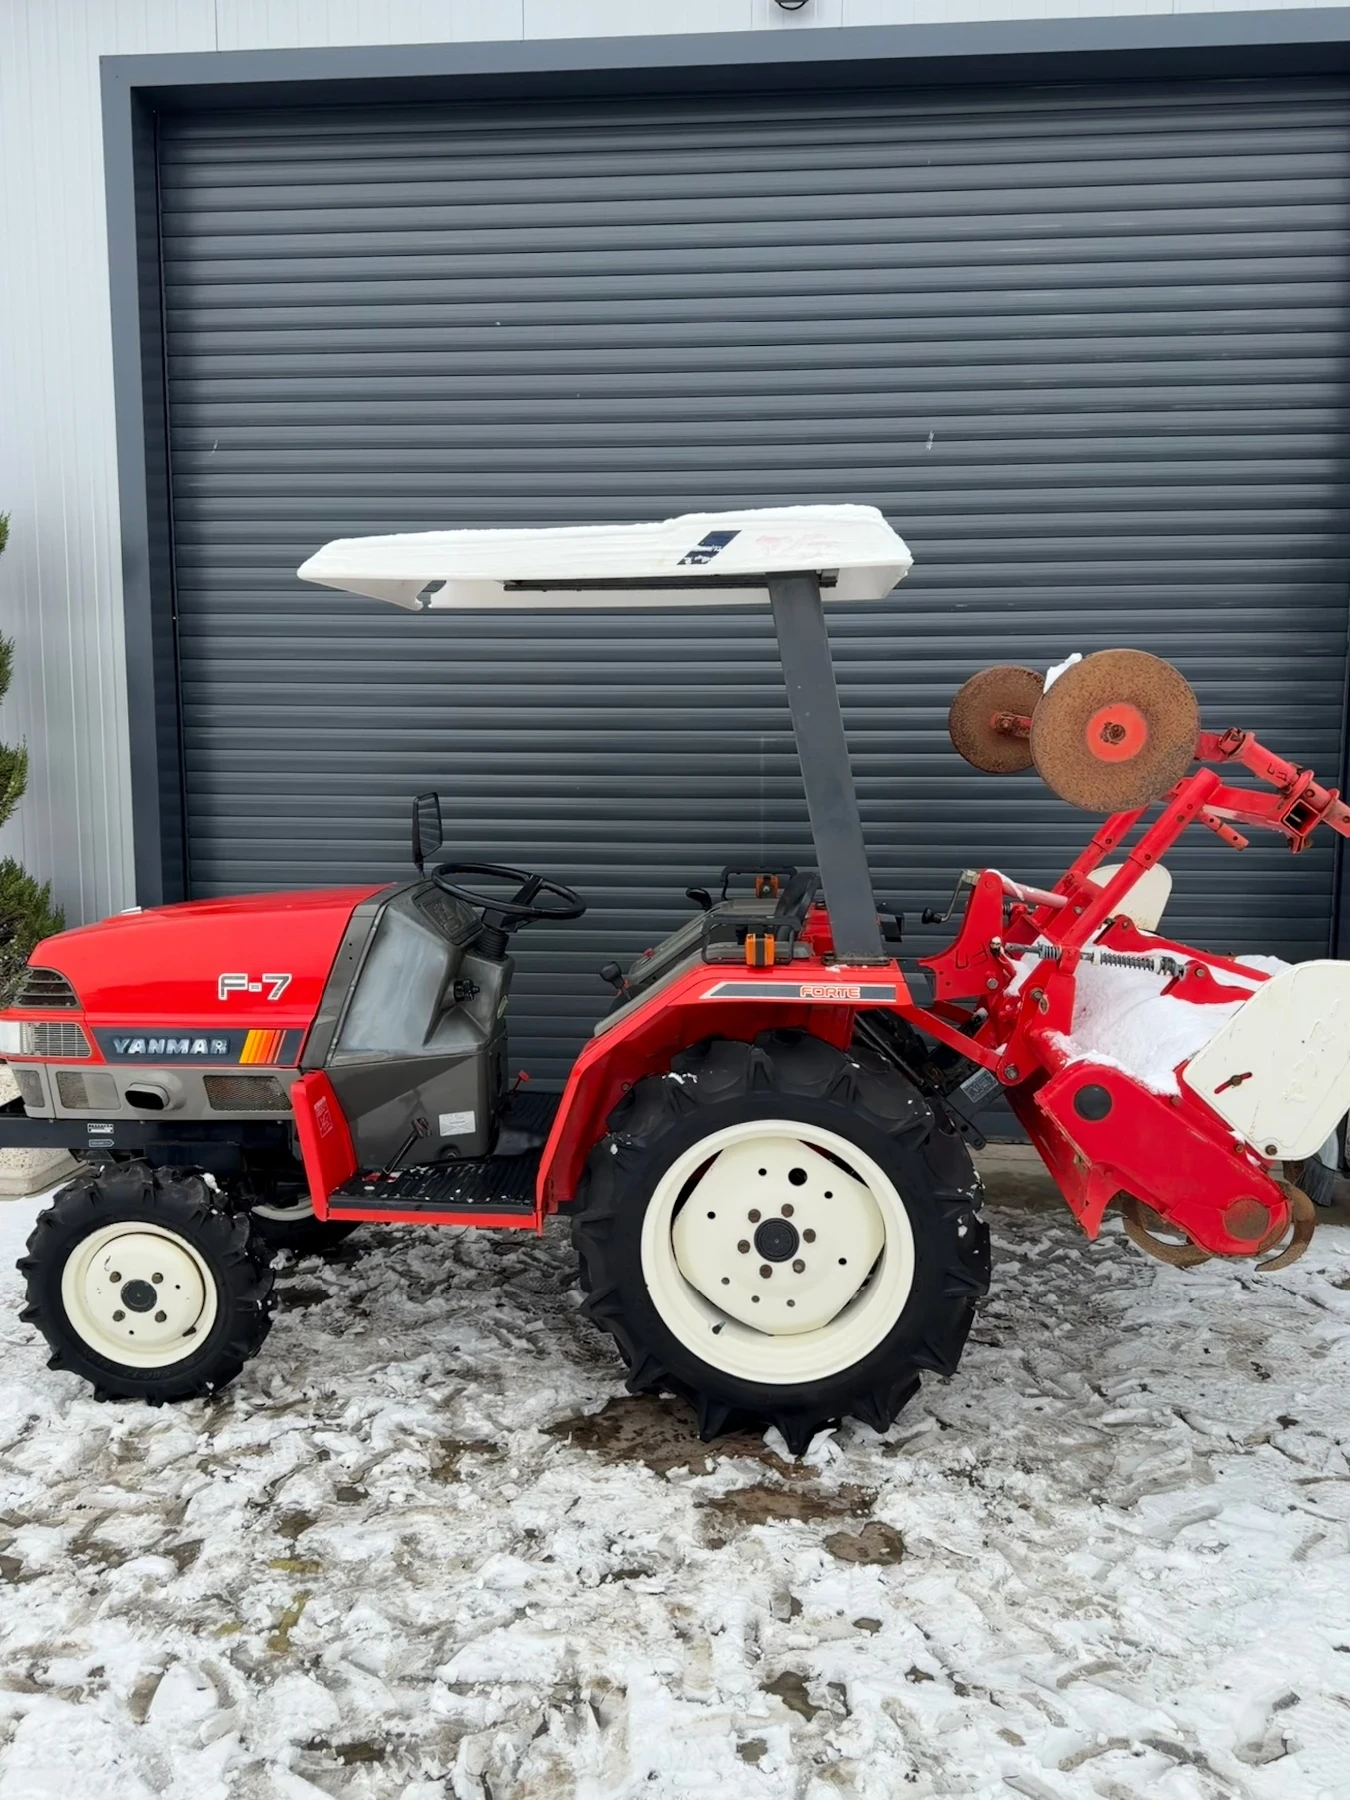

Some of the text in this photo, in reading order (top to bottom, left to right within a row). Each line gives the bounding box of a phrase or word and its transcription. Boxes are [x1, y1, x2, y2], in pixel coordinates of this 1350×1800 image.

[218, 973, 292, 1000] F-7
[801, 985, 860, 998] FORTE
[113, 1037, 229, 1055] YANMAR
